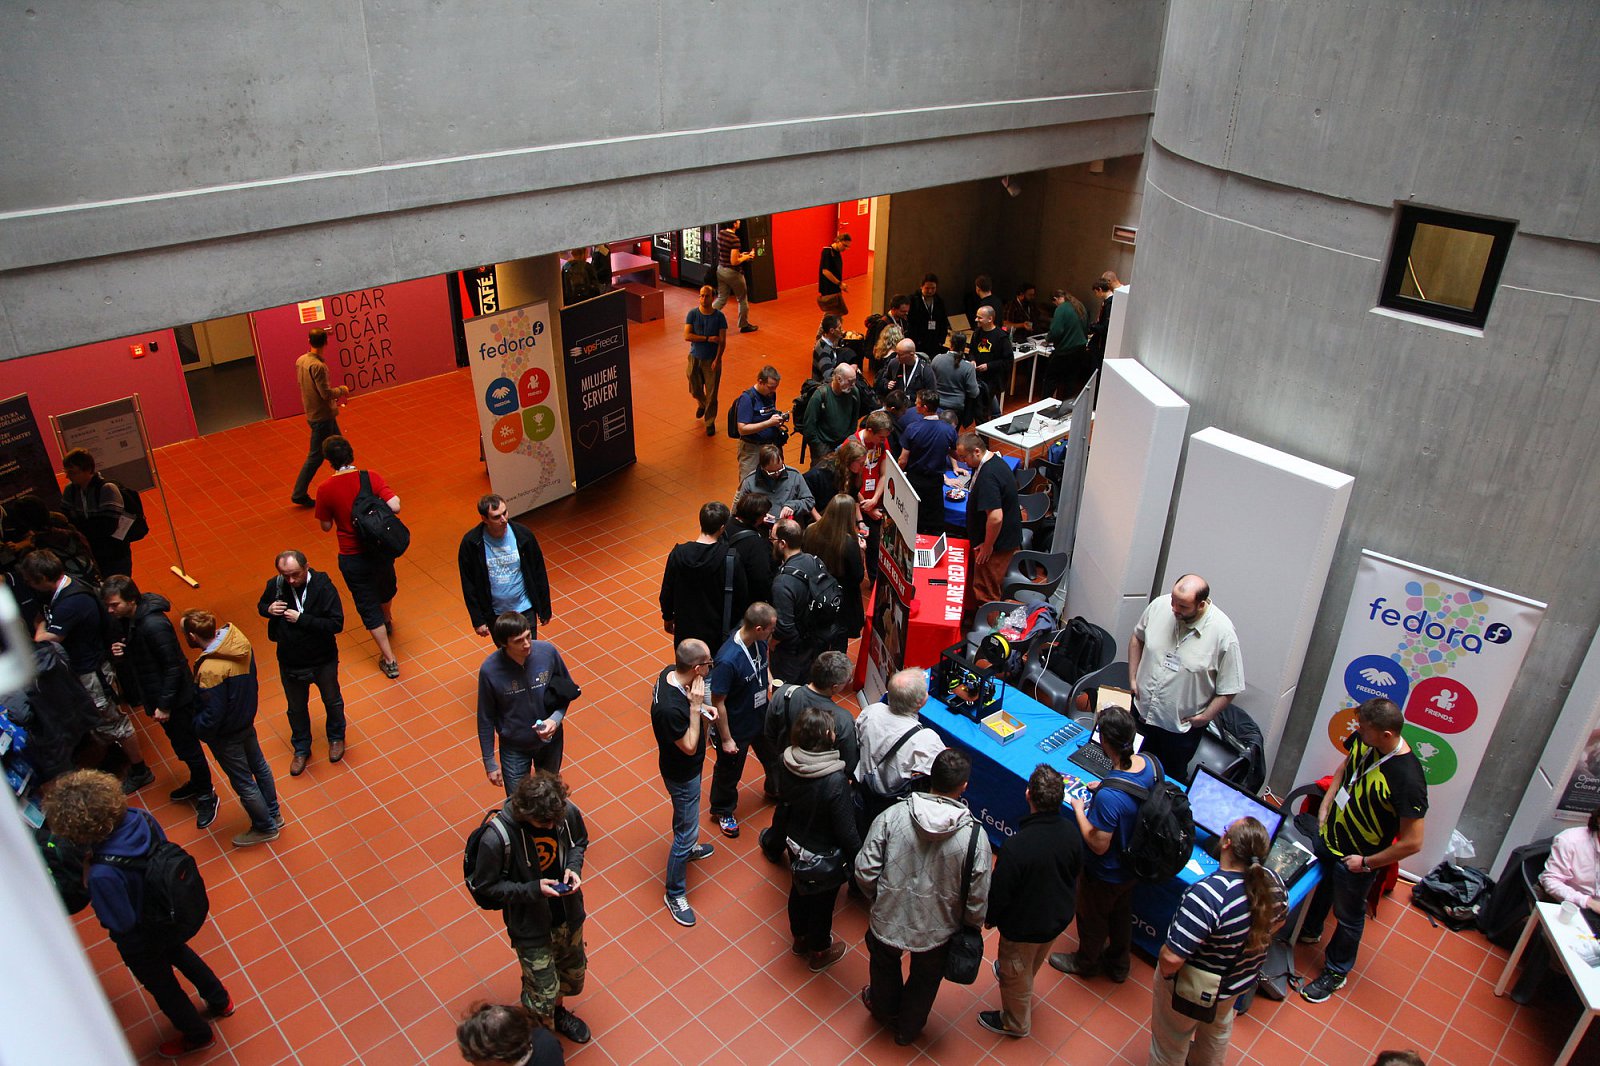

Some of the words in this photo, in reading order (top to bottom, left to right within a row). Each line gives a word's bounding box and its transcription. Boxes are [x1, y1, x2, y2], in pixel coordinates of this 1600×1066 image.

[335, 312, 389, 342] OČÁR
[340, 337, 392, 367] OČÁR
[479, 336, 536, 360] fedora
[344, 362, 396, 392] OČÁR
[581, 365, 618, 393] MILUJEME
[582, 382, 618, 411] SERVERY
[949, 546, 965, 565] HAT
[948, 566, 965, 583] RED
[946, 584, 965, 604] ARE
[944, 605, 963, 621] WE
[1369, 597, 1482, 654] fedora
[1356, 684, 1389, 699] FREEDOM.
[1425, 708, 1454, 723] FRIENDS.
[1574, 781, 1597, 791] Close
[1578, 774, 1600, 784] Open
[981, 808, 1016, 837] fedo
